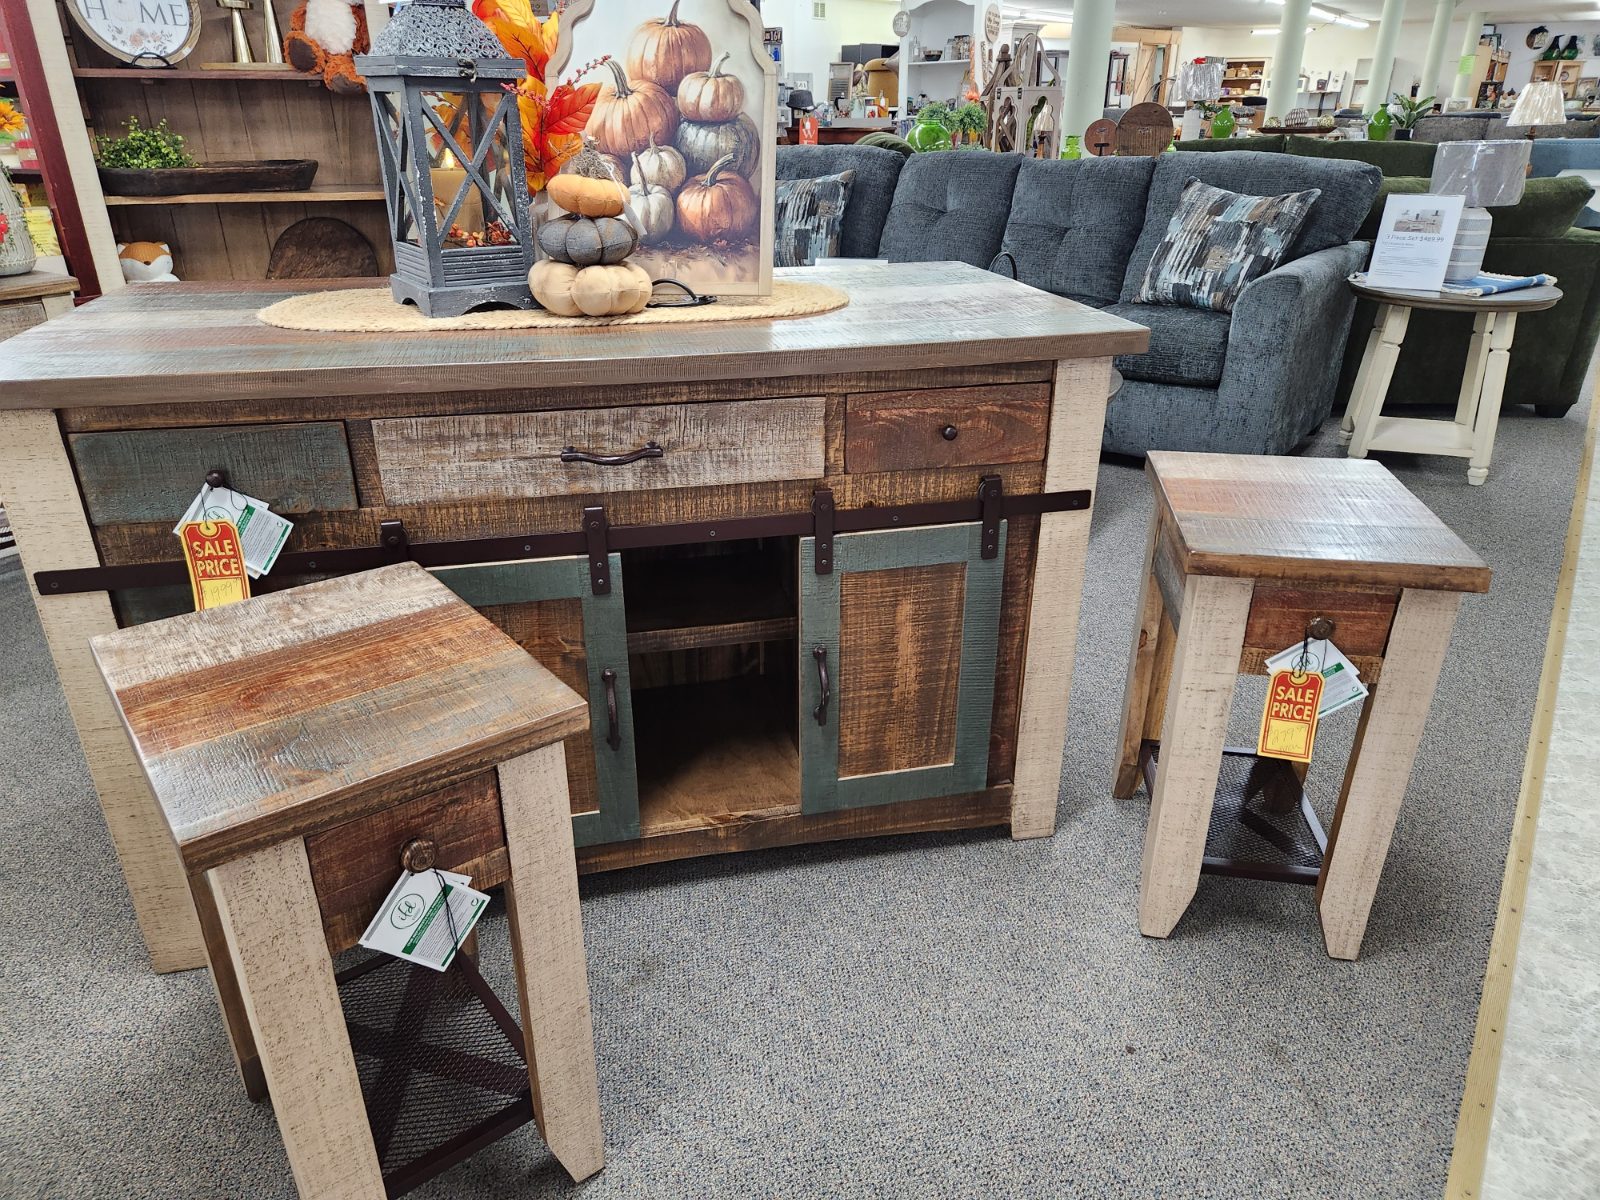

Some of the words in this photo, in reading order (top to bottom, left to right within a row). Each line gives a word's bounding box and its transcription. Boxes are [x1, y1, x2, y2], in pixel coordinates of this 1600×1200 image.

[192, 540, 234, 558] SALE
[195, 558, 241, 577] PRICE
[1275, 686, 1315, 704] SALE
[1271, 702, 1313, 721] PRICE
